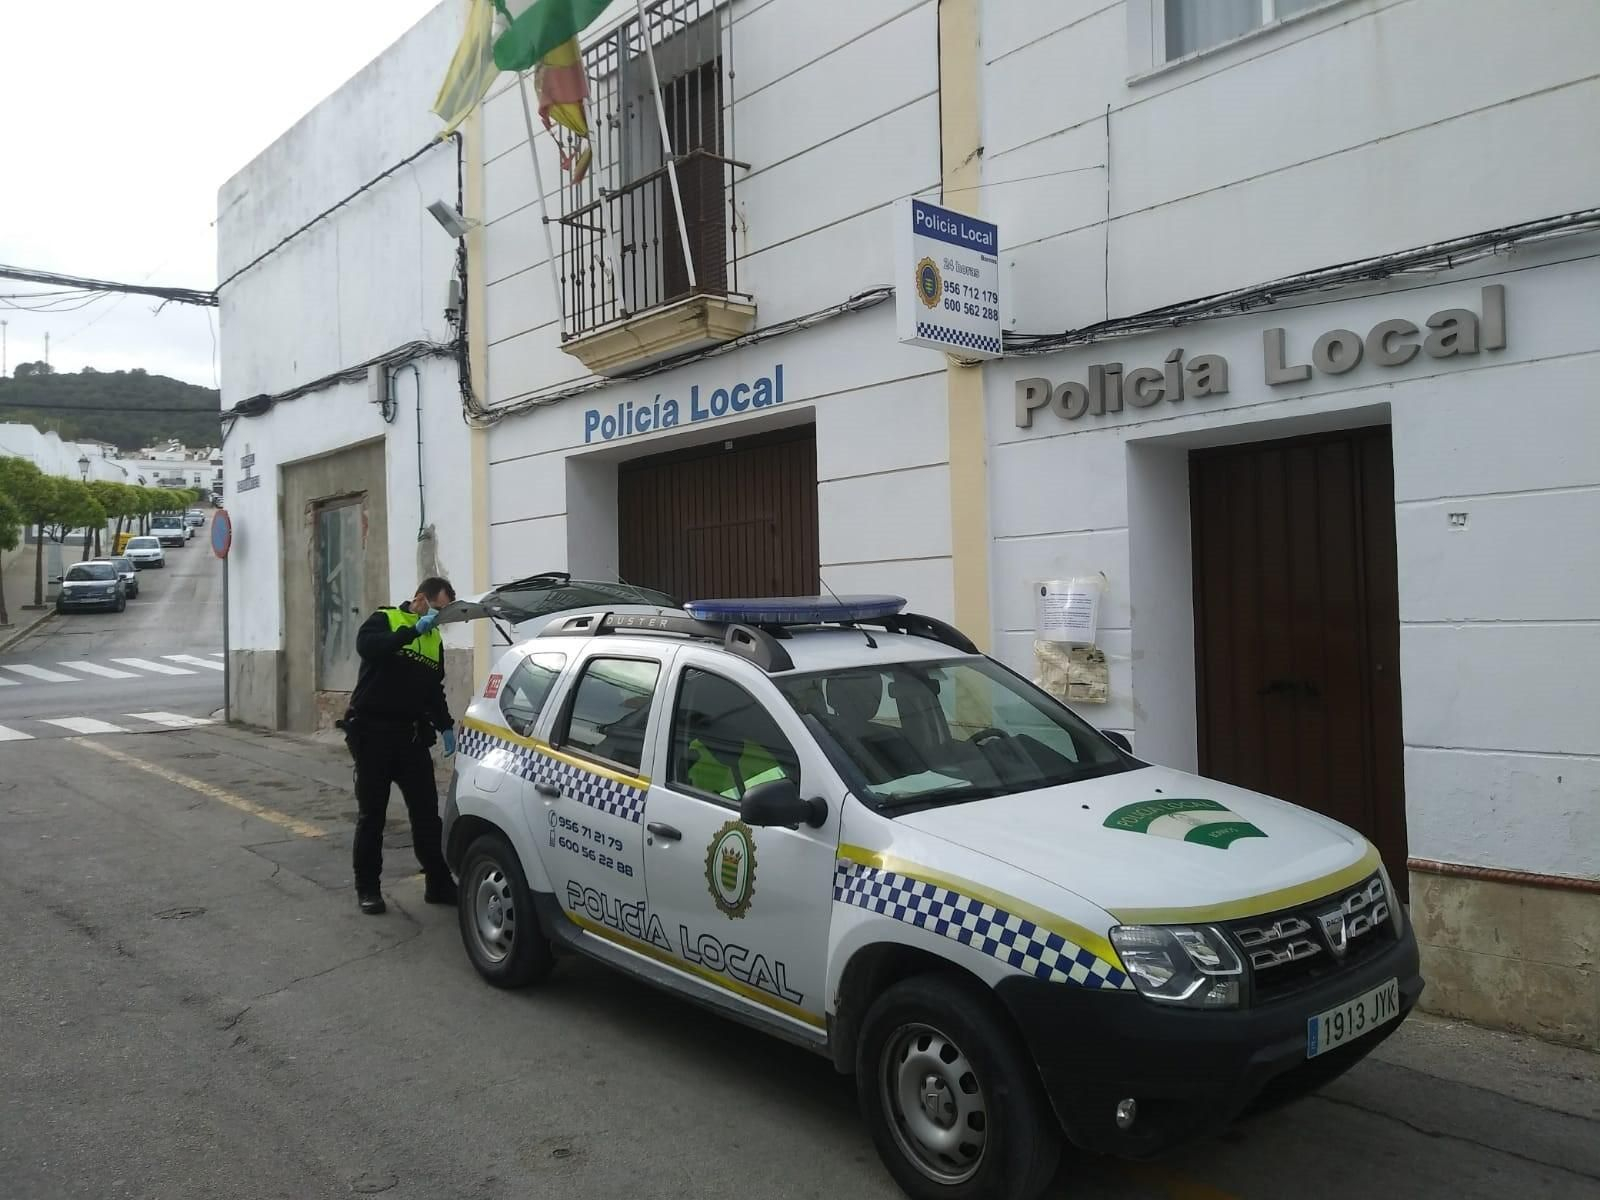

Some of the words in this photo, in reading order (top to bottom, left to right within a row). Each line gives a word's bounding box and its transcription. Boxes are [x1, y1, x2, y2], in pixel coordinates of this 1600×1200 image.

[961, 223, 993, 246] Local
[943, 257, 954, 271] 24
[955, 260, 980, 278] horas
[943, 280, 961, 295] 956
[962, 284, 979, 300] 712
[982, 290, 998, 304] 179
[944, 297, 961, 312] 600
[963, 302, 980, 317] 562
[982, 306, 999, 321] 288
[1014, 348, 1229, 428] Policía
[1263, 284, 1507, 386] Local
[584, 393, 679, 444] Policía
[690, 363, 784, 422] Local
[606, 616, 669, 628] DUSTER
[558, 816, 579, 833] 956
[581, 825, 592, 839] 71
[593, 831, 605, 845] 21
[607, 836, 623, 852] 79
[558, 836, 579, 853] 600
[581, 846, 596, 862] 56
[598, 854, 614, 869] 22
[616, 861, 634, 878] 88
[679, 924, 804, 1006] LOCAL
[1324, 1001, 1365, 1046] 1913
[1370, 983, 1395, 1023] JYK
